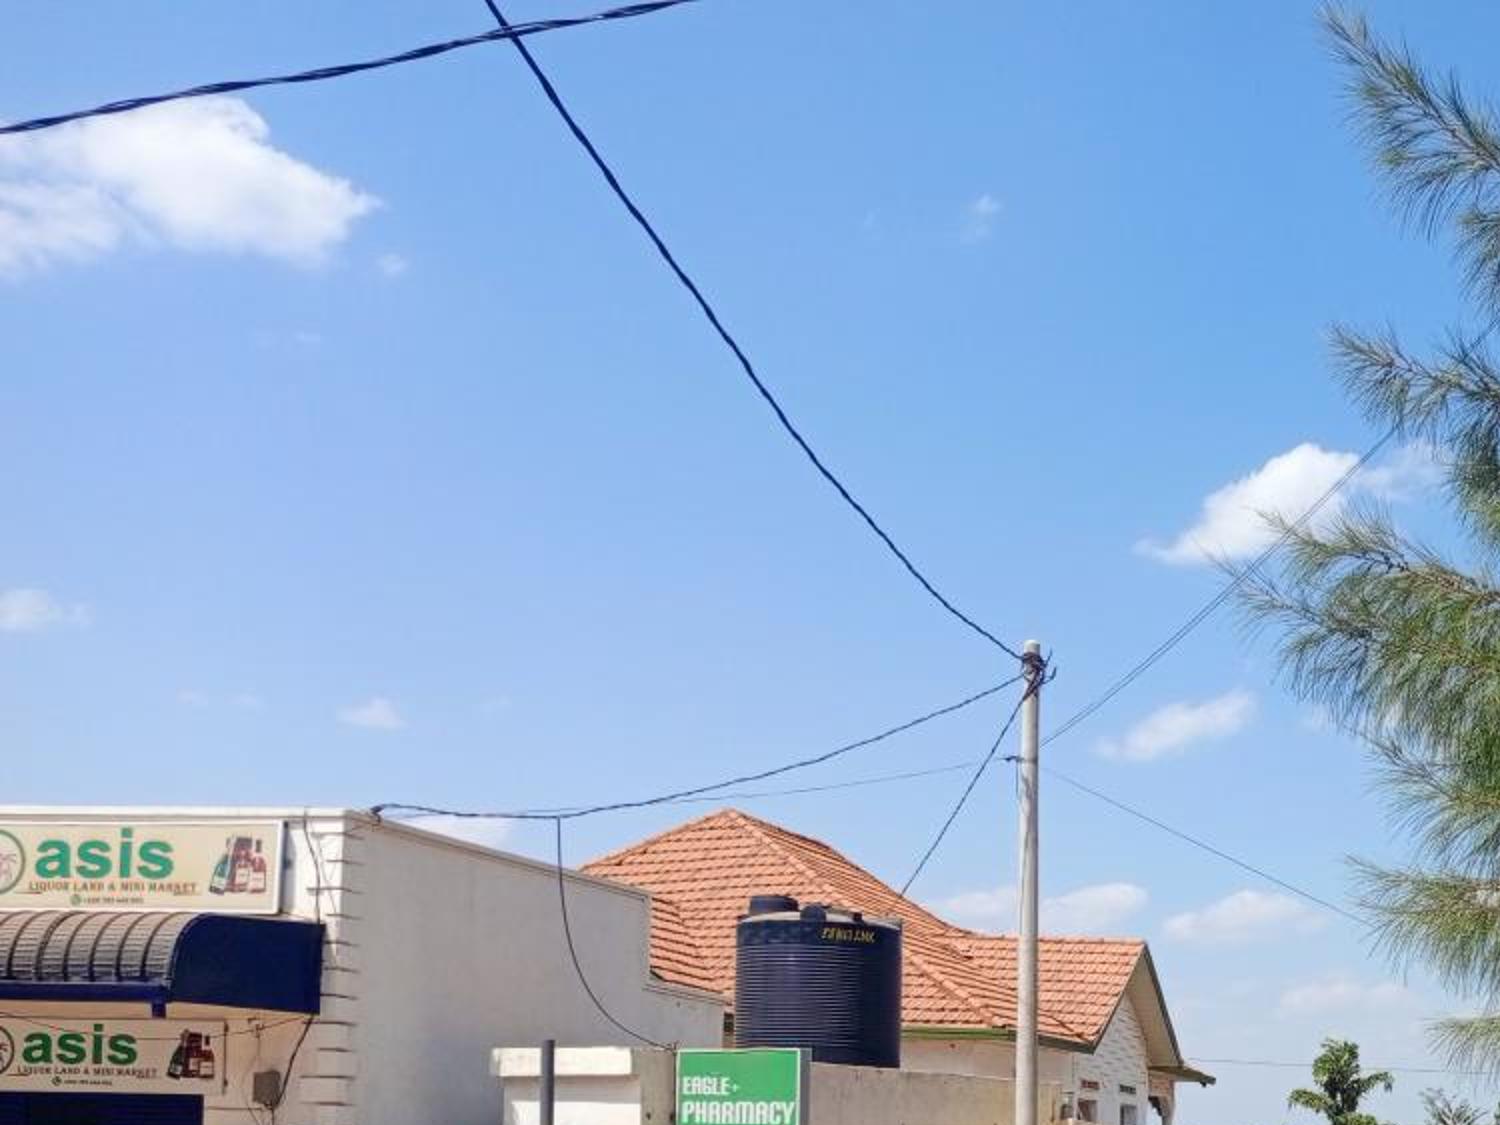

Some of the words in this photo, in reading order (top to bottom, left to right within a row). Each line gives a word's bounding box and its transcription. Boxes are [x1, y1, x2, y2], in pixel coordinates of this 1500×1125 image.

[35, 827, 174, 879] asis
[22, 1024, 138, 1065] asis
[682, 1076, 731, 1095] EAGLE
[682, 1101, 795, 1125] PHARMACY
